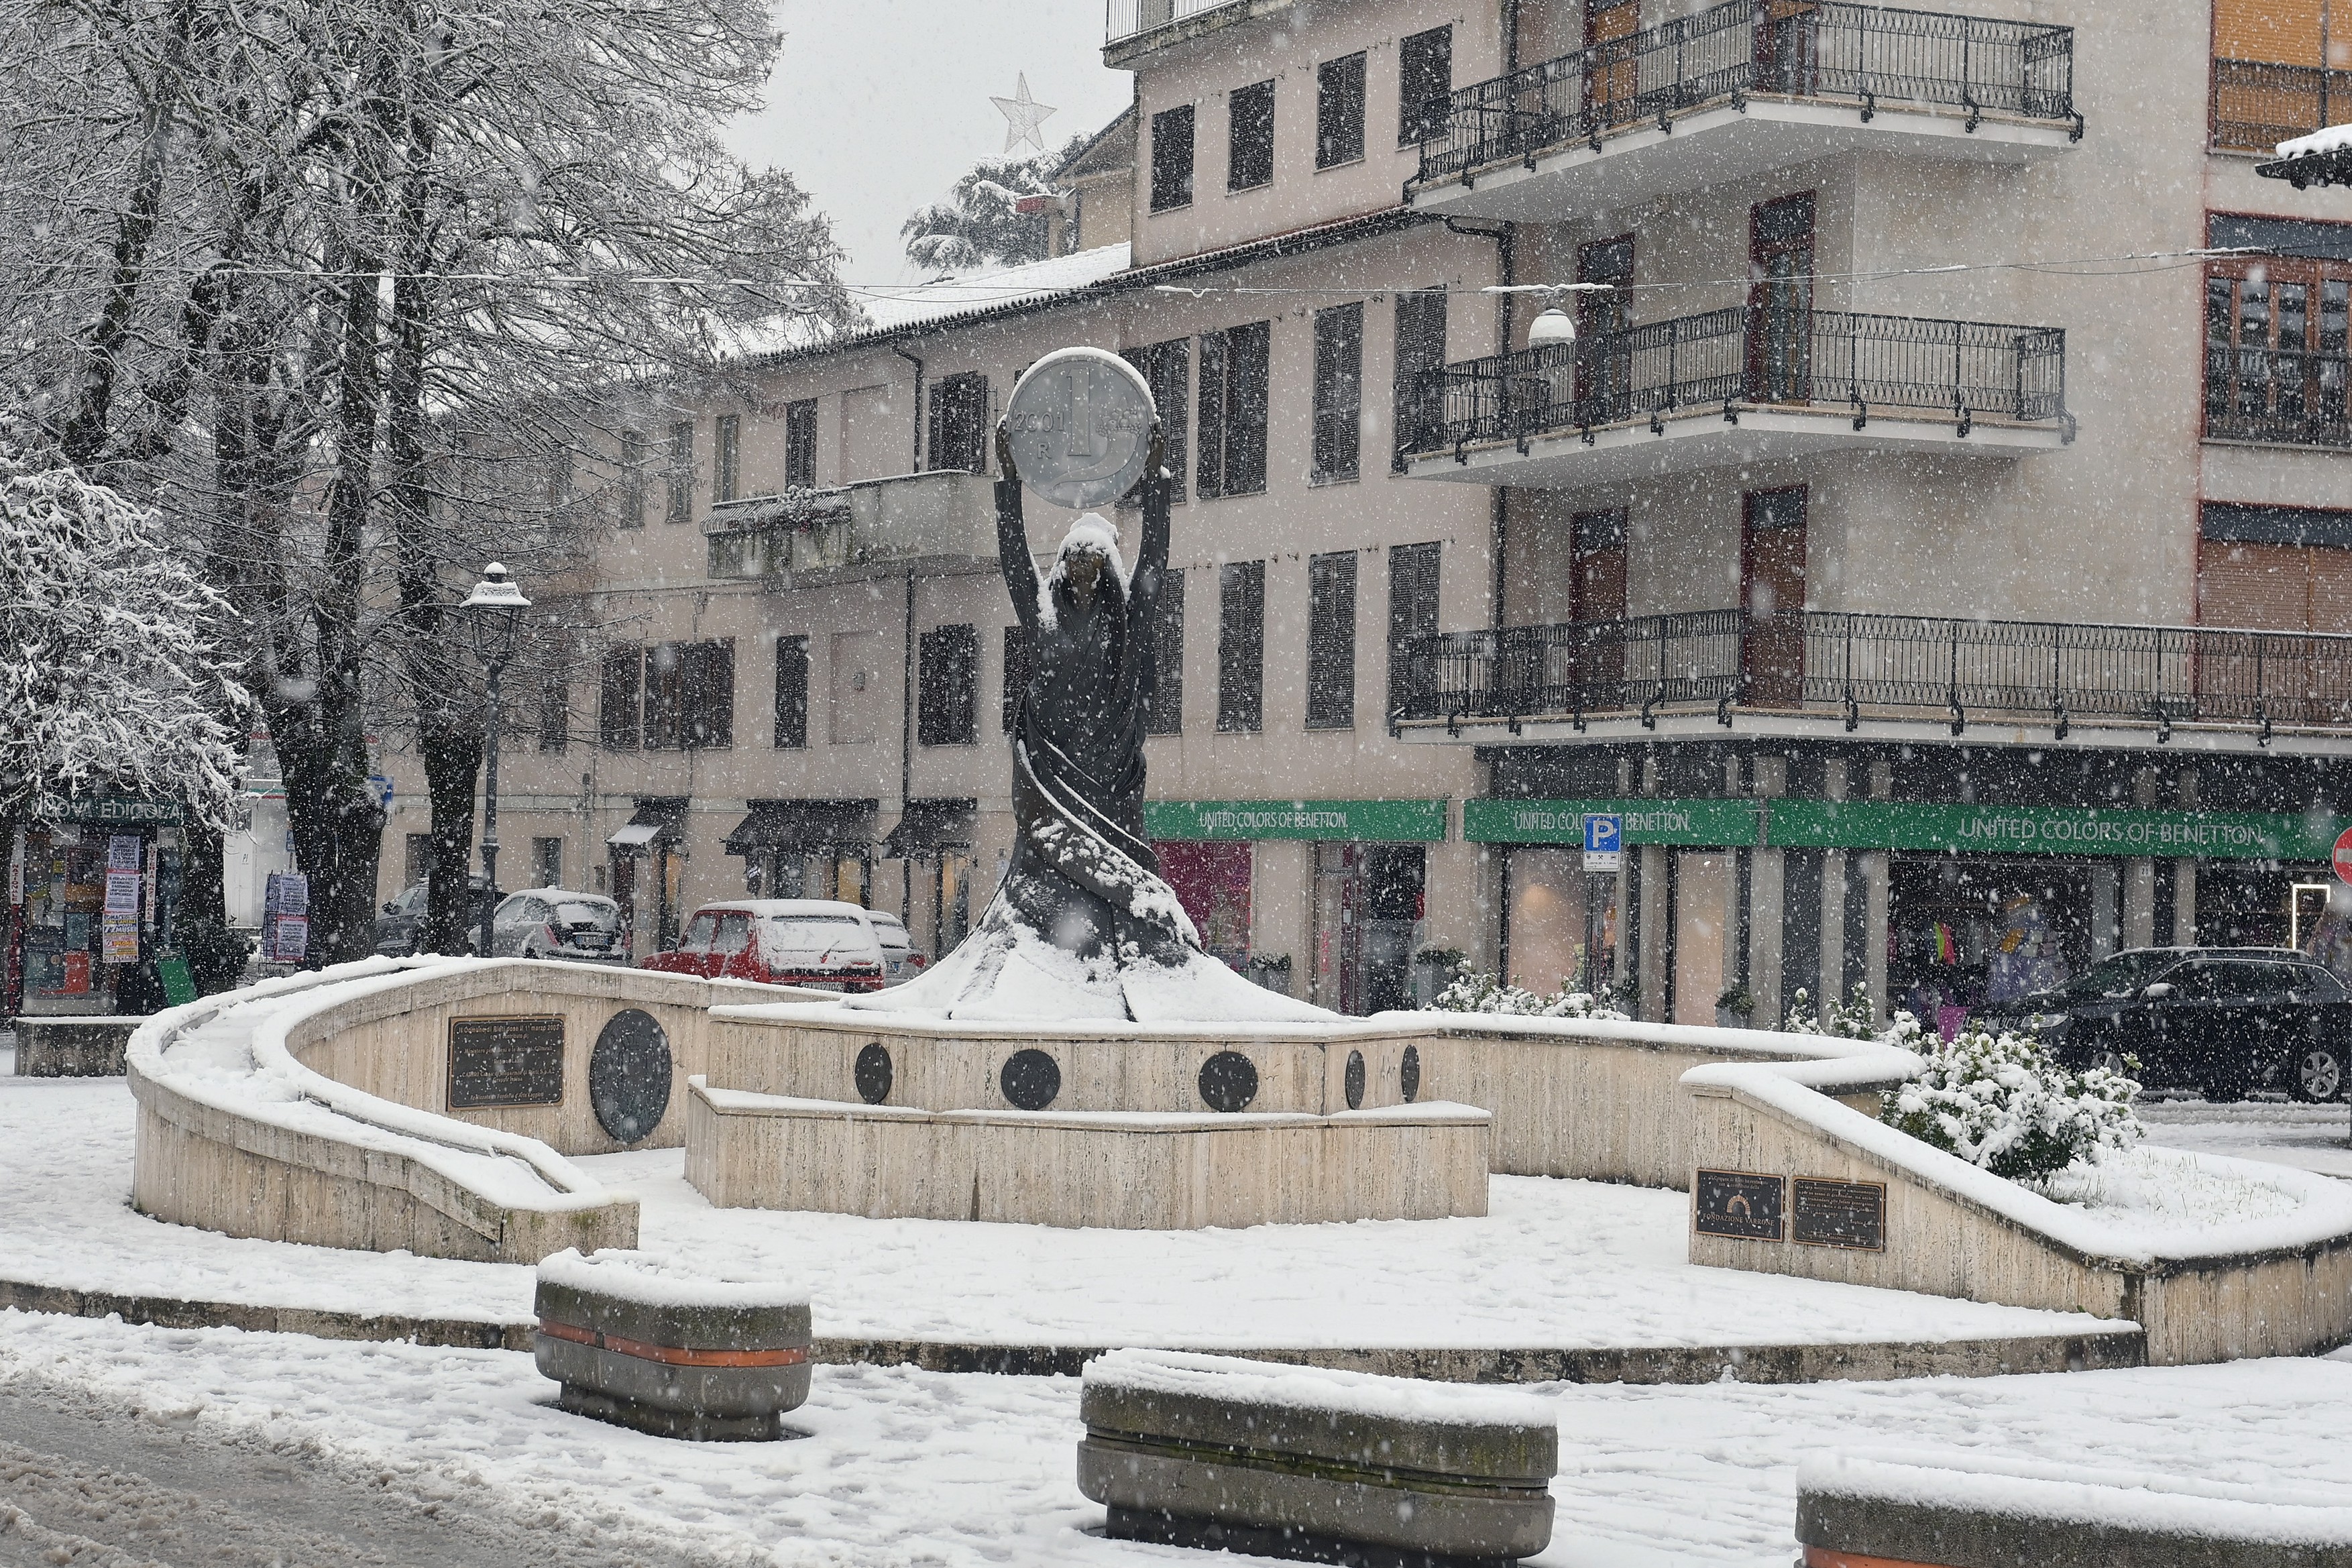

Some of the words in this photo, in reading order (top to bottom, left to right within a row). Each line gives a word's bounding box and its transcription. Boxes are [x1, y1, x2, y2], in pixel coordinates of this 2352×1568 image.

[1066, 368, 1091, 457] 1
[1014, 412, 1065, 432] 2001
[1037, 443, 1052, 459] R
[101, 802, 180, 819] EDICOLA
[1200, 811, 1235, 828] UNITED
[1237, 811, 1276, 828] COLORS
[1278, 812, 1292, 828] OF
[1514, 812, 1555, 830] UNITED
[1961, 818, 2036, 838] UNITED
[2041, 820, 2123, 841] COLORS
[2127, 822, 2155, 842] OF
[1592, 820, 1614, 848] P
[146, 883, 155, 919] NAZIONALE
[506, 1026, 518, 1034] pose
[1703, 1213, 1744, 1223] FONDAZIONE
[1745, 1217, 1775, 1226] VARRONE
